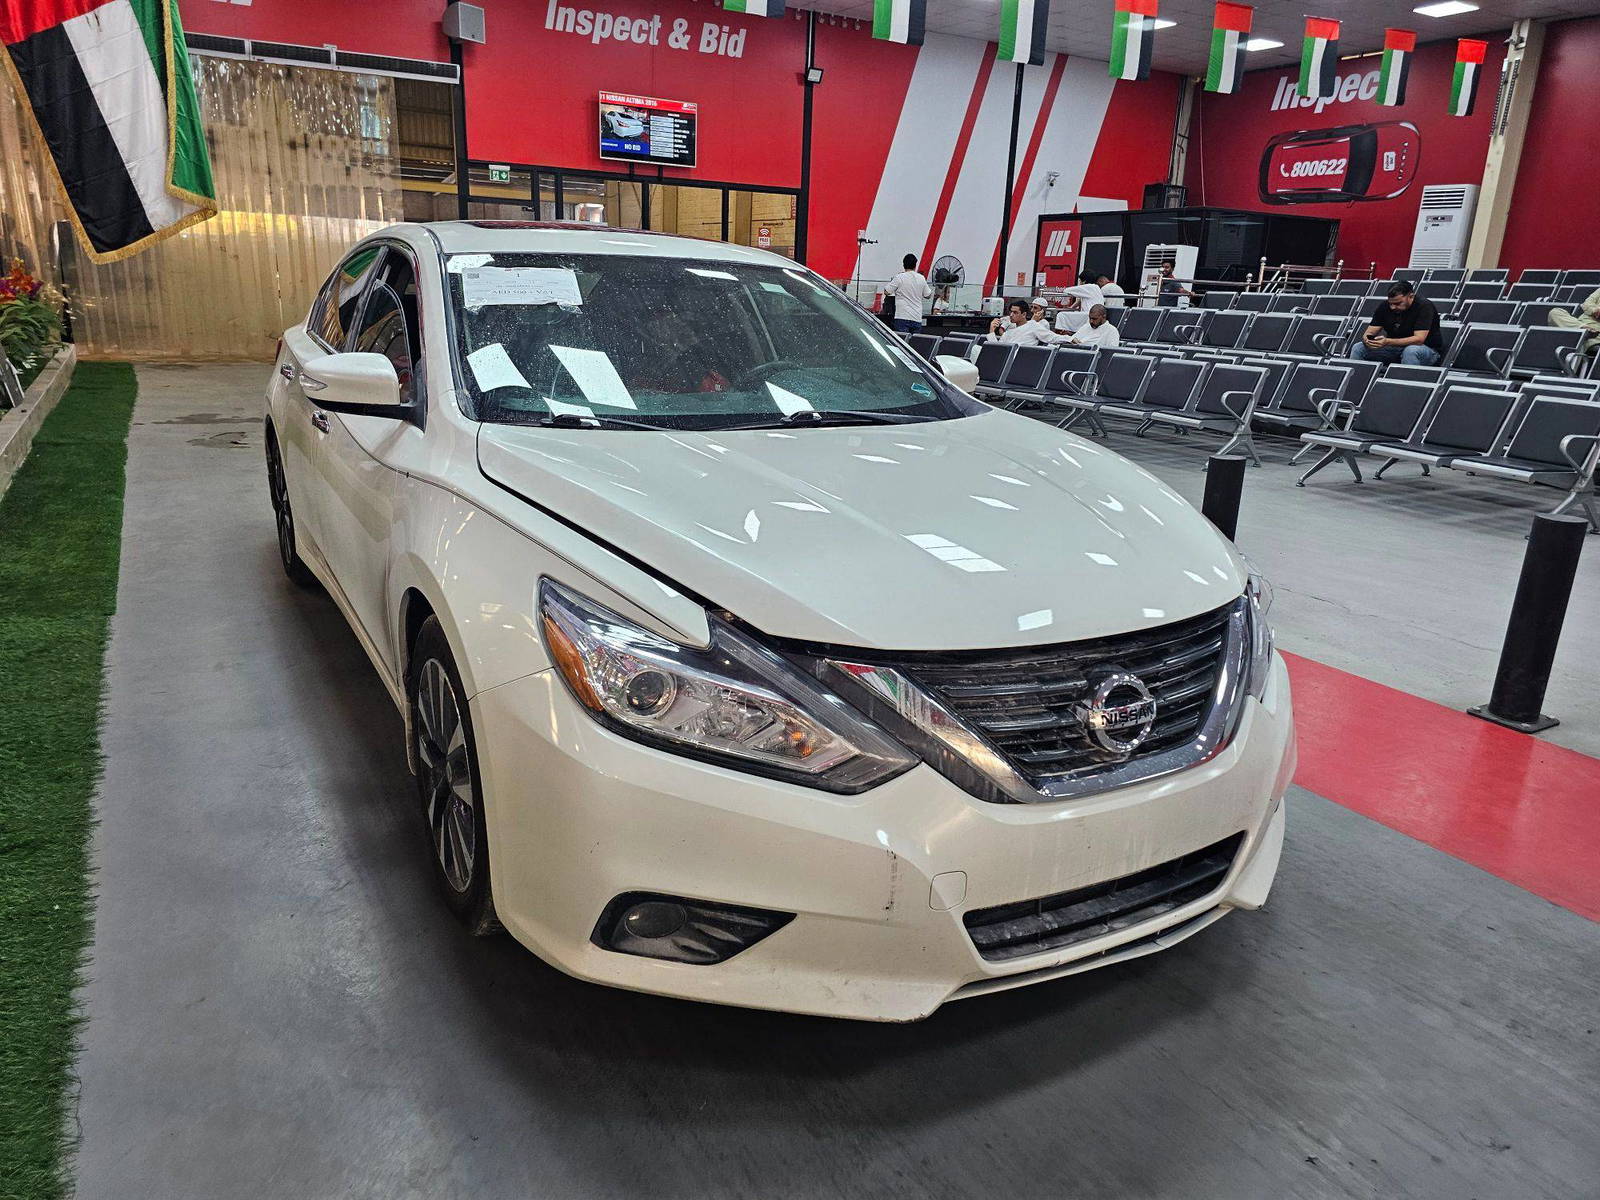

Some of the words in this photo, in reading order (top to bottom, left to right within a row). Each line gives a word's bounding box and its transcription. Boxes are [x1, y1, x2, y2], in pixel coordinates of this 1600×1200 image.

[544, 0, 661, 45] Inspect
[668, 18, 691, 50] &
[699, 22, 747, 58] Bid
[1290, 158, 1347, 178] 800622
[1100, 704, 1154, 726] NISSAN
